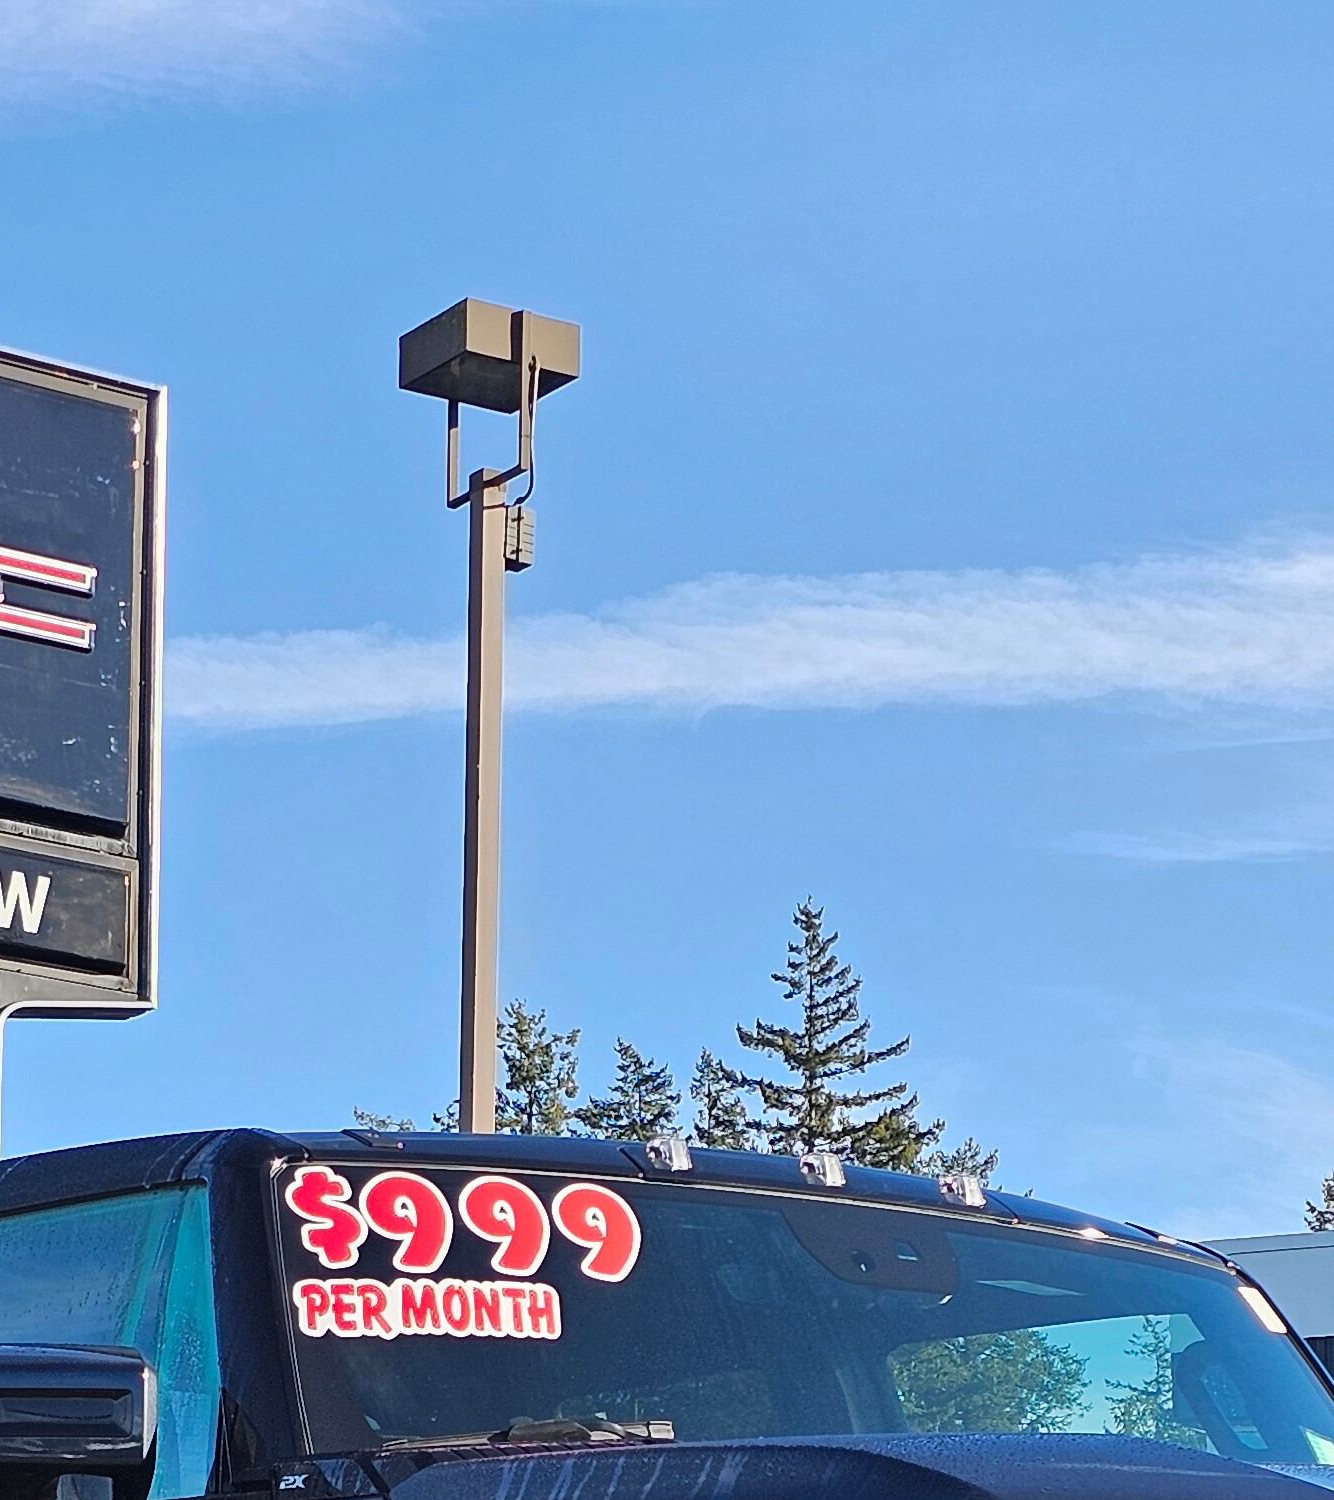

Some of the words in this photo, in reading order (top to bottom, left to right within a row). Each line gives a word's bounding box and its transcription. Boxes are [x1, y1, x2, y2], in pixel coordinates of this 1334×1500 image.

[285, 1166, 642, 1283] $999
[295, 1279, 396, 1339] PER
[399, 1279, 561, 1340] MONTH
